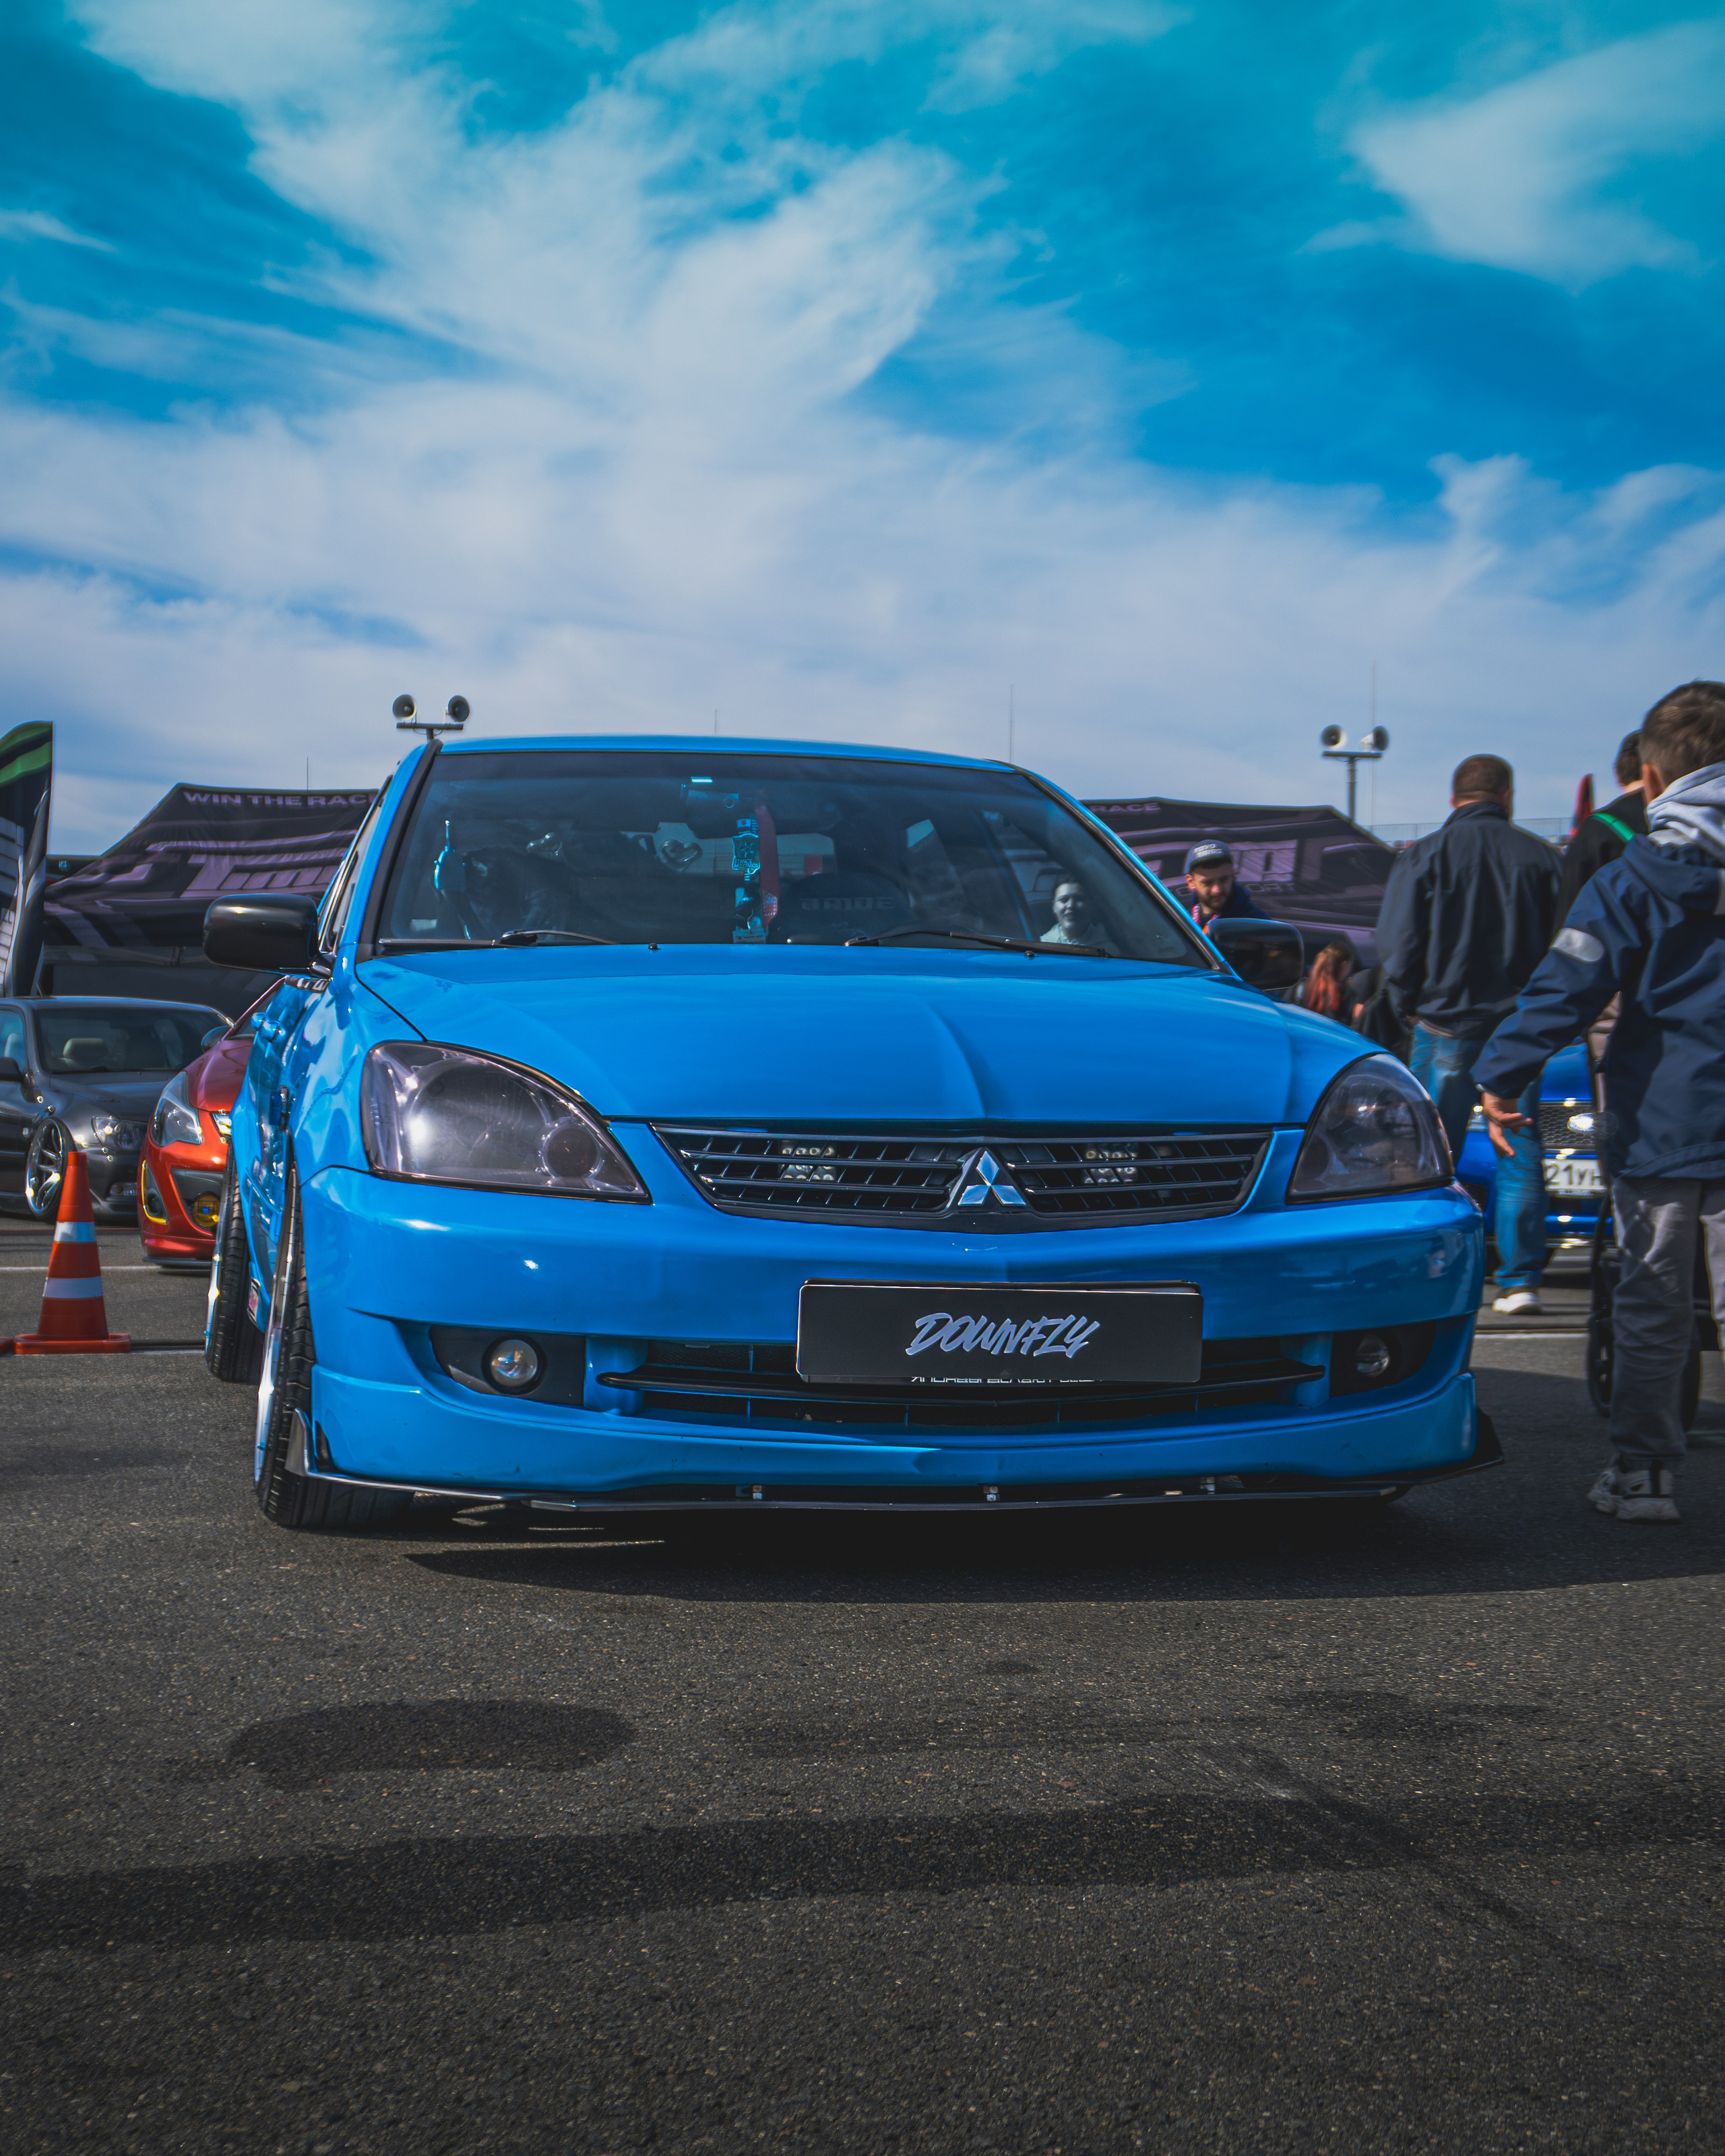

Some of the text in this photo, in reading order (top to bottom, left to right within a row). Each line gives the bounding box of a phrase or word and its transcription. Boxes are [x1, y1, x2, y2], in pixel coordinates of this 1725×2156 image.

[183, 792, 241, 804] WIN
[247, 795, 301, 806] THE
[1089, 802, 1160, 813] RACE
[1193, 844, 1216, 853] TOYO
[905, 1312, 1100, 1358] DOWNFLY
